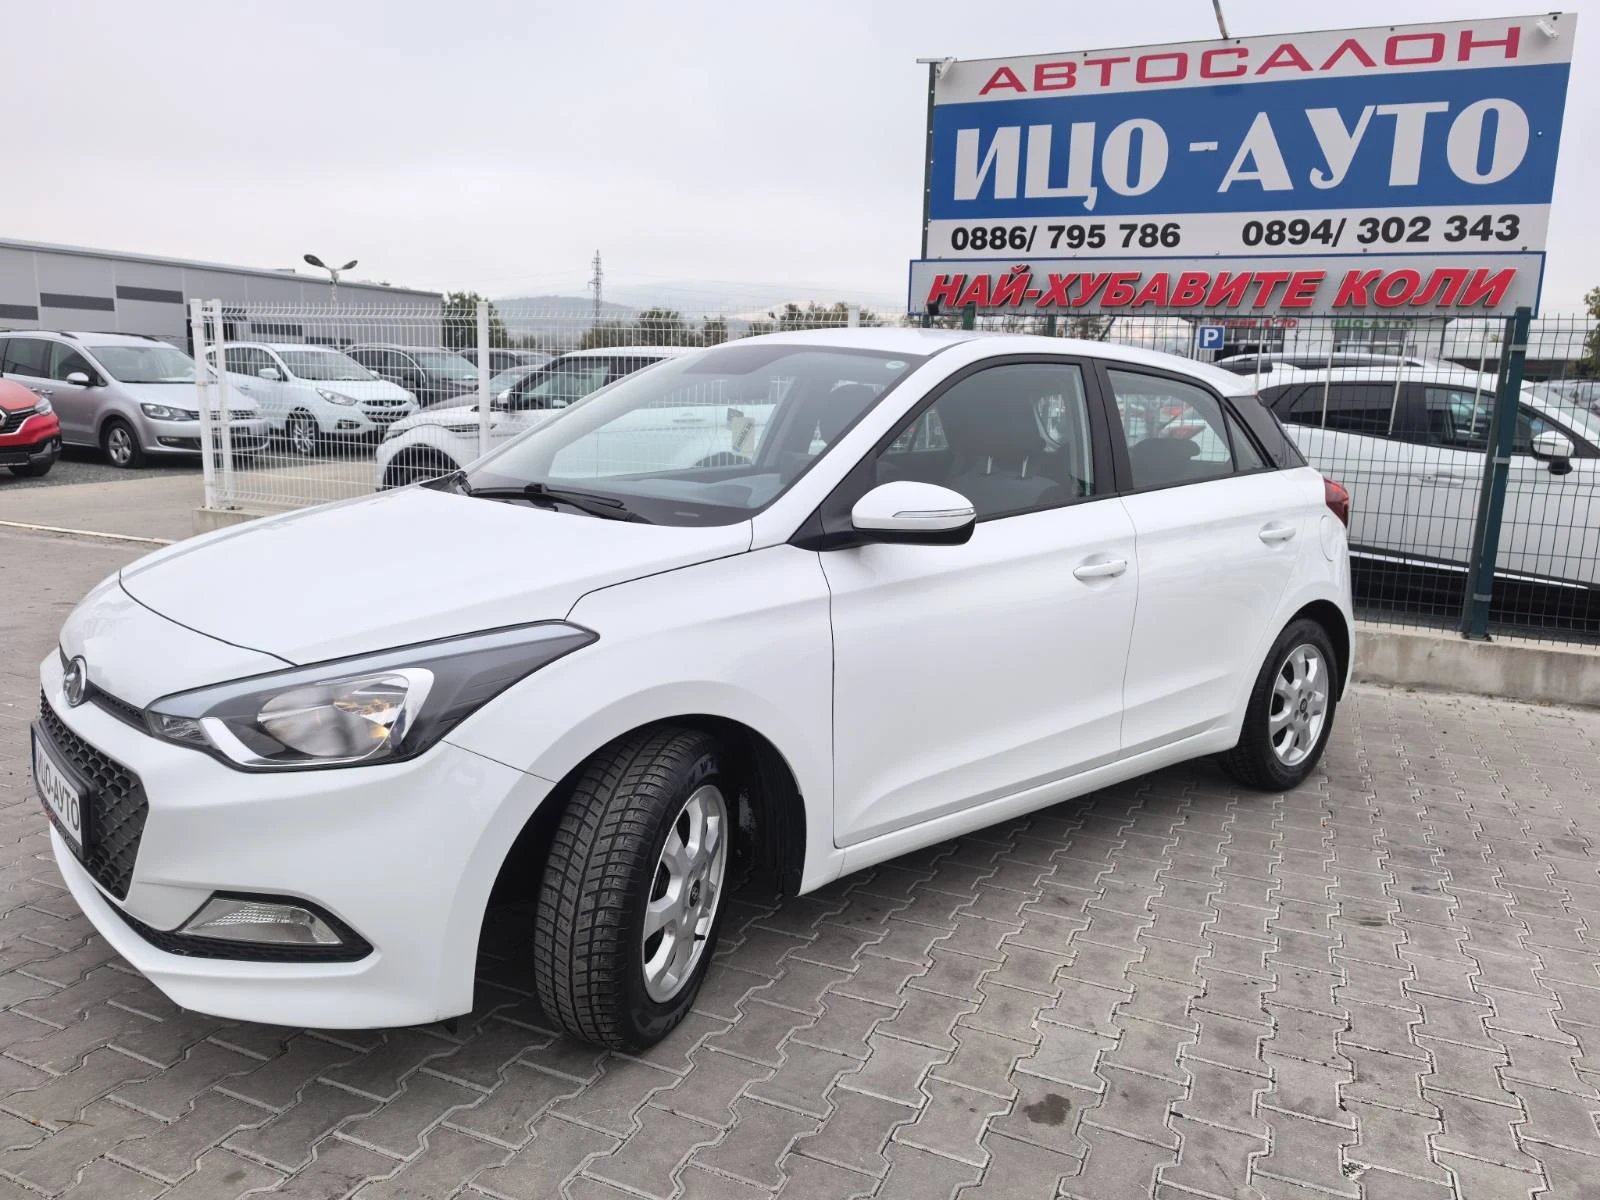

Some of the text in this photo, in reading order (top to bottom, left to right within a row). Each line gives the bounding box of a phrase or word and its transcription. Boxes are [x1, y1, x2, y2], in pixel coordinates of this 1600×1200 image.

[978, 27, 1521, 96] АВТОСАЛОН
[951, 222, 1181, 252] 0886/ 795 786
[1242, 214, 1520, 247] 0894/ 302 343
[927, 264, 1518, 308] НАЙ-ХУБАВИТЕ КОЛИ
[1203, 328, 1219, 347] P
